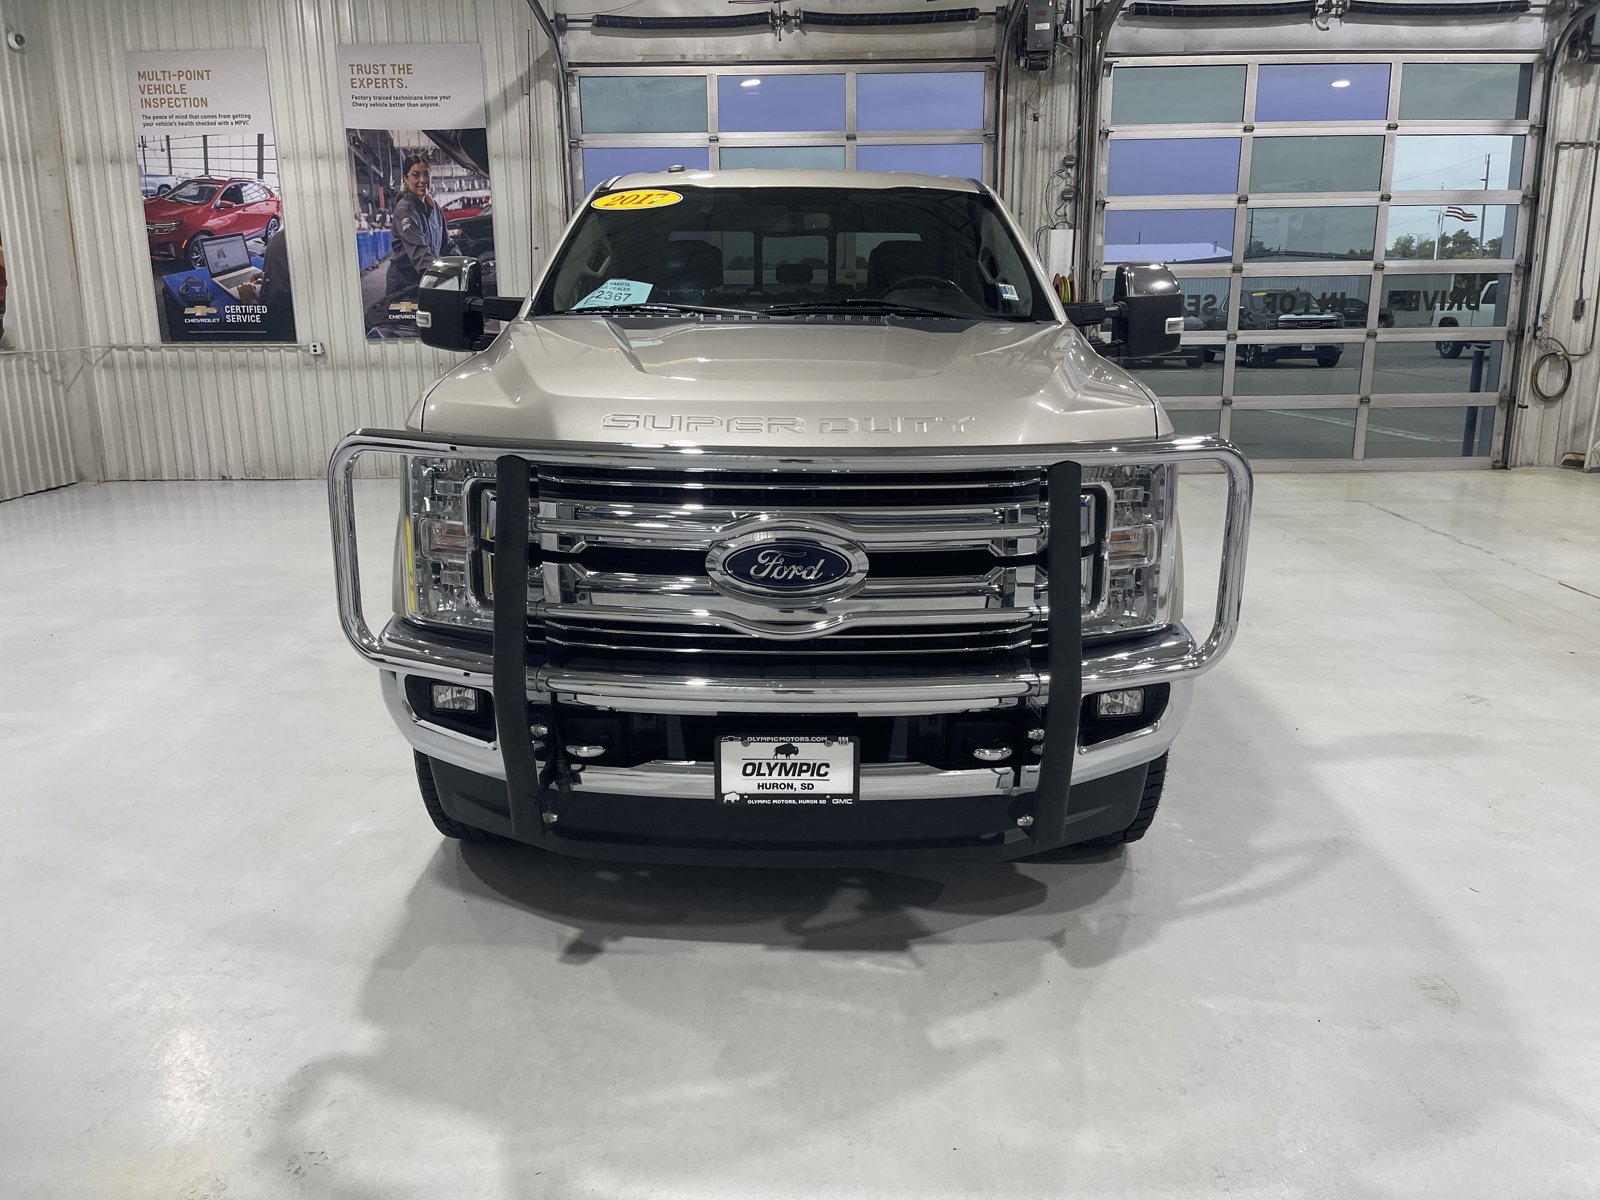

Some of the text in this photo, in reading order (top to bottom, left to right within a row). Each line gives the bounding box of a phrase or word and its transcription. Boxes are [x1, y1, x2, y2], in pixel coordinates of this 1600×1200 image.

[348, 63, 414, 75] TRUST THE
[137, 69, 212, 82] MULTI-POINT
[350, 77, 408, 89] EXPERTS.
[138, 84, 187, 95] VEHICLE
[140, 97, 209, 109] INSPECTION
[351, 94, 371, 102] Factory
[603, 193, 668, 206] 2017
[224, 305, 268, 314] CERTIFIED
[225, 314, 262, 323] SERVICE
[601, 413, 976, 434] SUPER DUTY
[749, 549, 823, 581] Ford
[741, 762, 831, 778] OLYMPIC
[757, 783, 815, 792] HURON, SD
